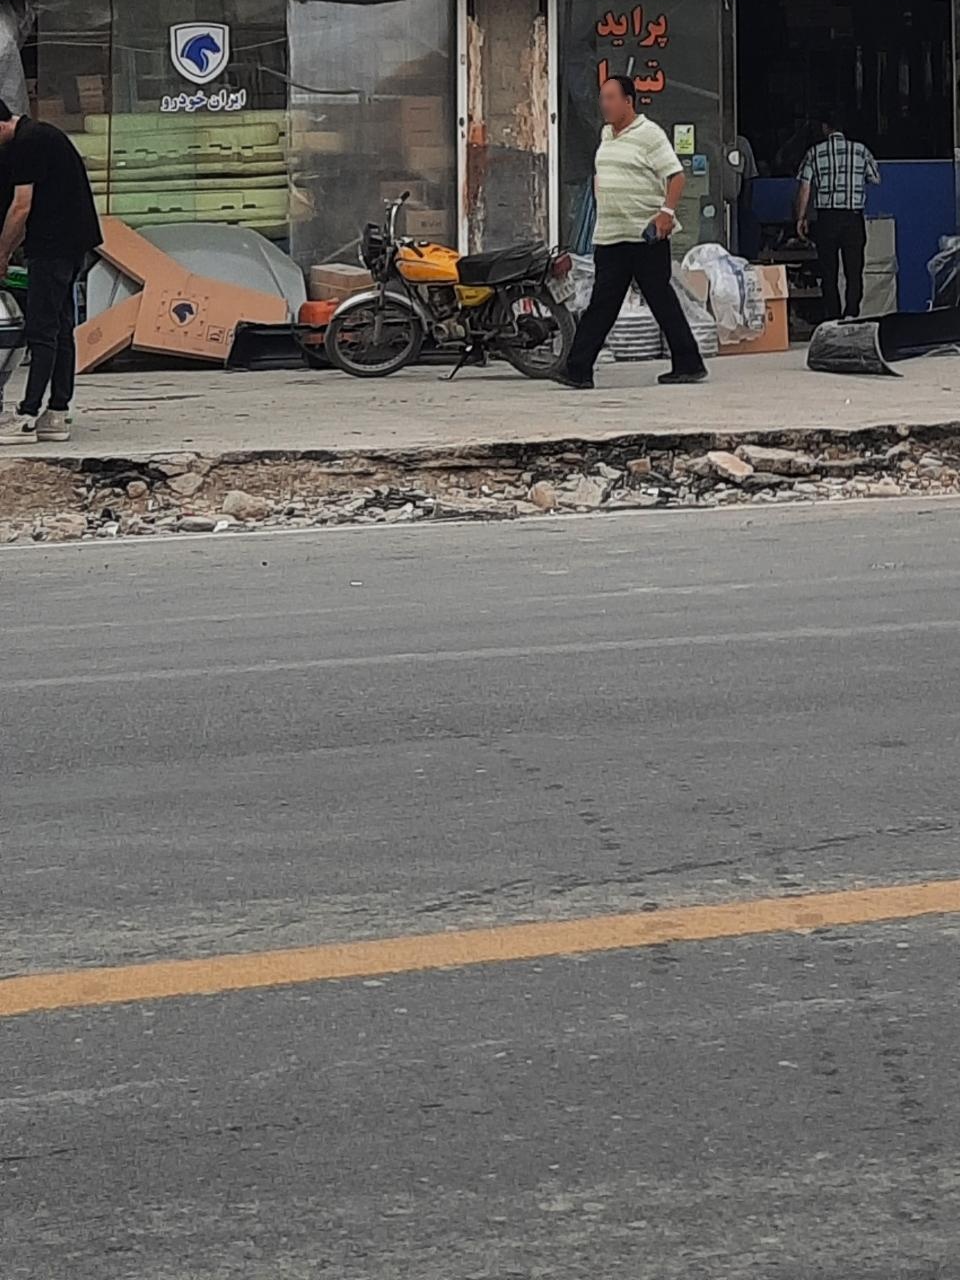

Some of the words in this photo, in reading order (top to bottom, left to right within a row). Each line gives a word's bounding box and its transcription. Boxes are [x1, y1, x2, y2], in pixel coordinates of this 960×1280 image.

[597, 6, 668, 47] پراید
[160, 90, 208, 111] خودرو
[207, 88, 246, 110] ایران
